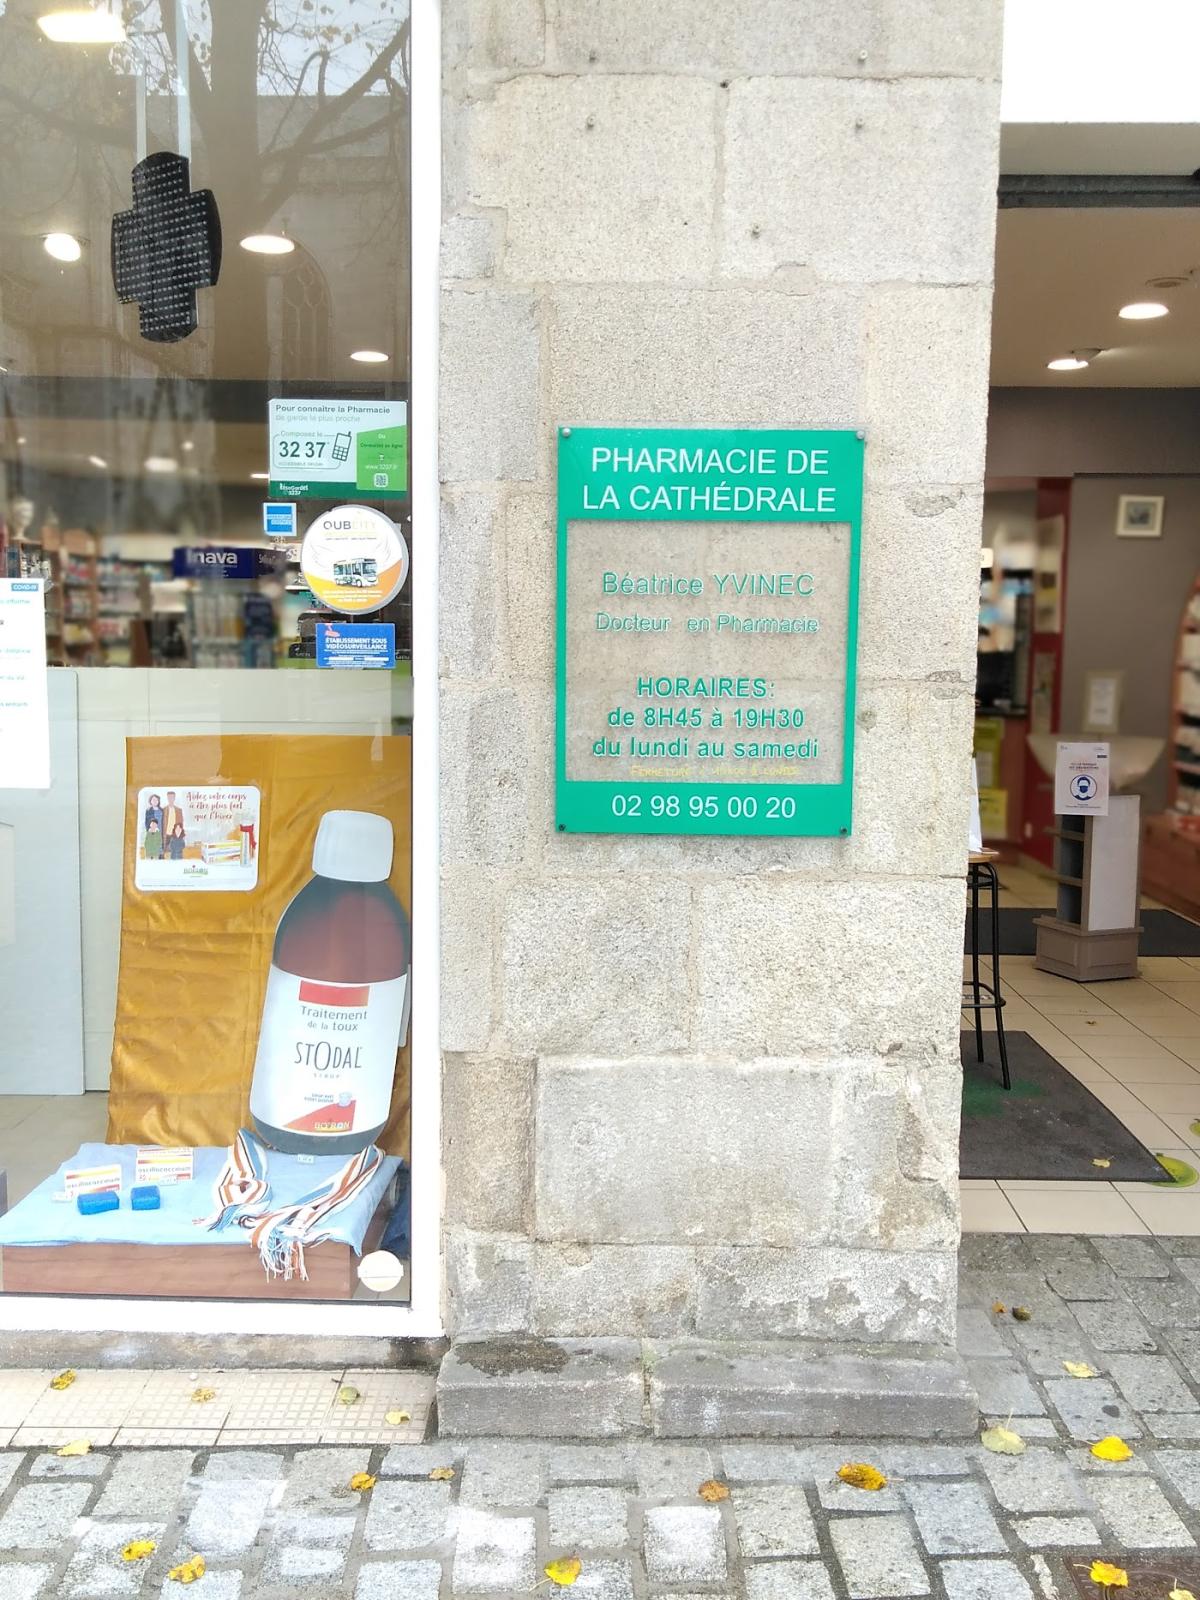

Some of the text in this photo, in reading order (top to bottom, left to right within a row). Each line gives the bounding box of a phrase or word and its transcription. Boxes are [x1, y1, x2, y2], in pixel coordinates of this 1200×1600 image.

[275, 404, 295, 412] Pour
[338, 405, 345, 413] la
[347, 405, 391, 414] Pharmacie
[279, 441, 326, 458] 32 37
[592, 447, 829, 475] PHARMACIE DE
[583, 481, 836, 512] LA CATHÉDRALE
[602, 571, 815, 597] Béatrice YVINEC
[596, 612, 819, 633] Docteur en Pharmacie
[637, 676, 775, 698] HORAIRES:
[607, 706, 805, 728] de 8H45 à 19H30
[592, 737, 819, 758] du lundi au samedi
[186, 791, 247, 802] Aidez votre corps
[211, 801, 227, 811] plus
[229, 801, 243, 812] fort
[611, 795, 797, 819] 02 98 95 00 20
[301, 1005, 368, 1020] Traitement
[307, 1021, 359, 1032] de la toux
[294, 1041, 363, 1071] STODAL
